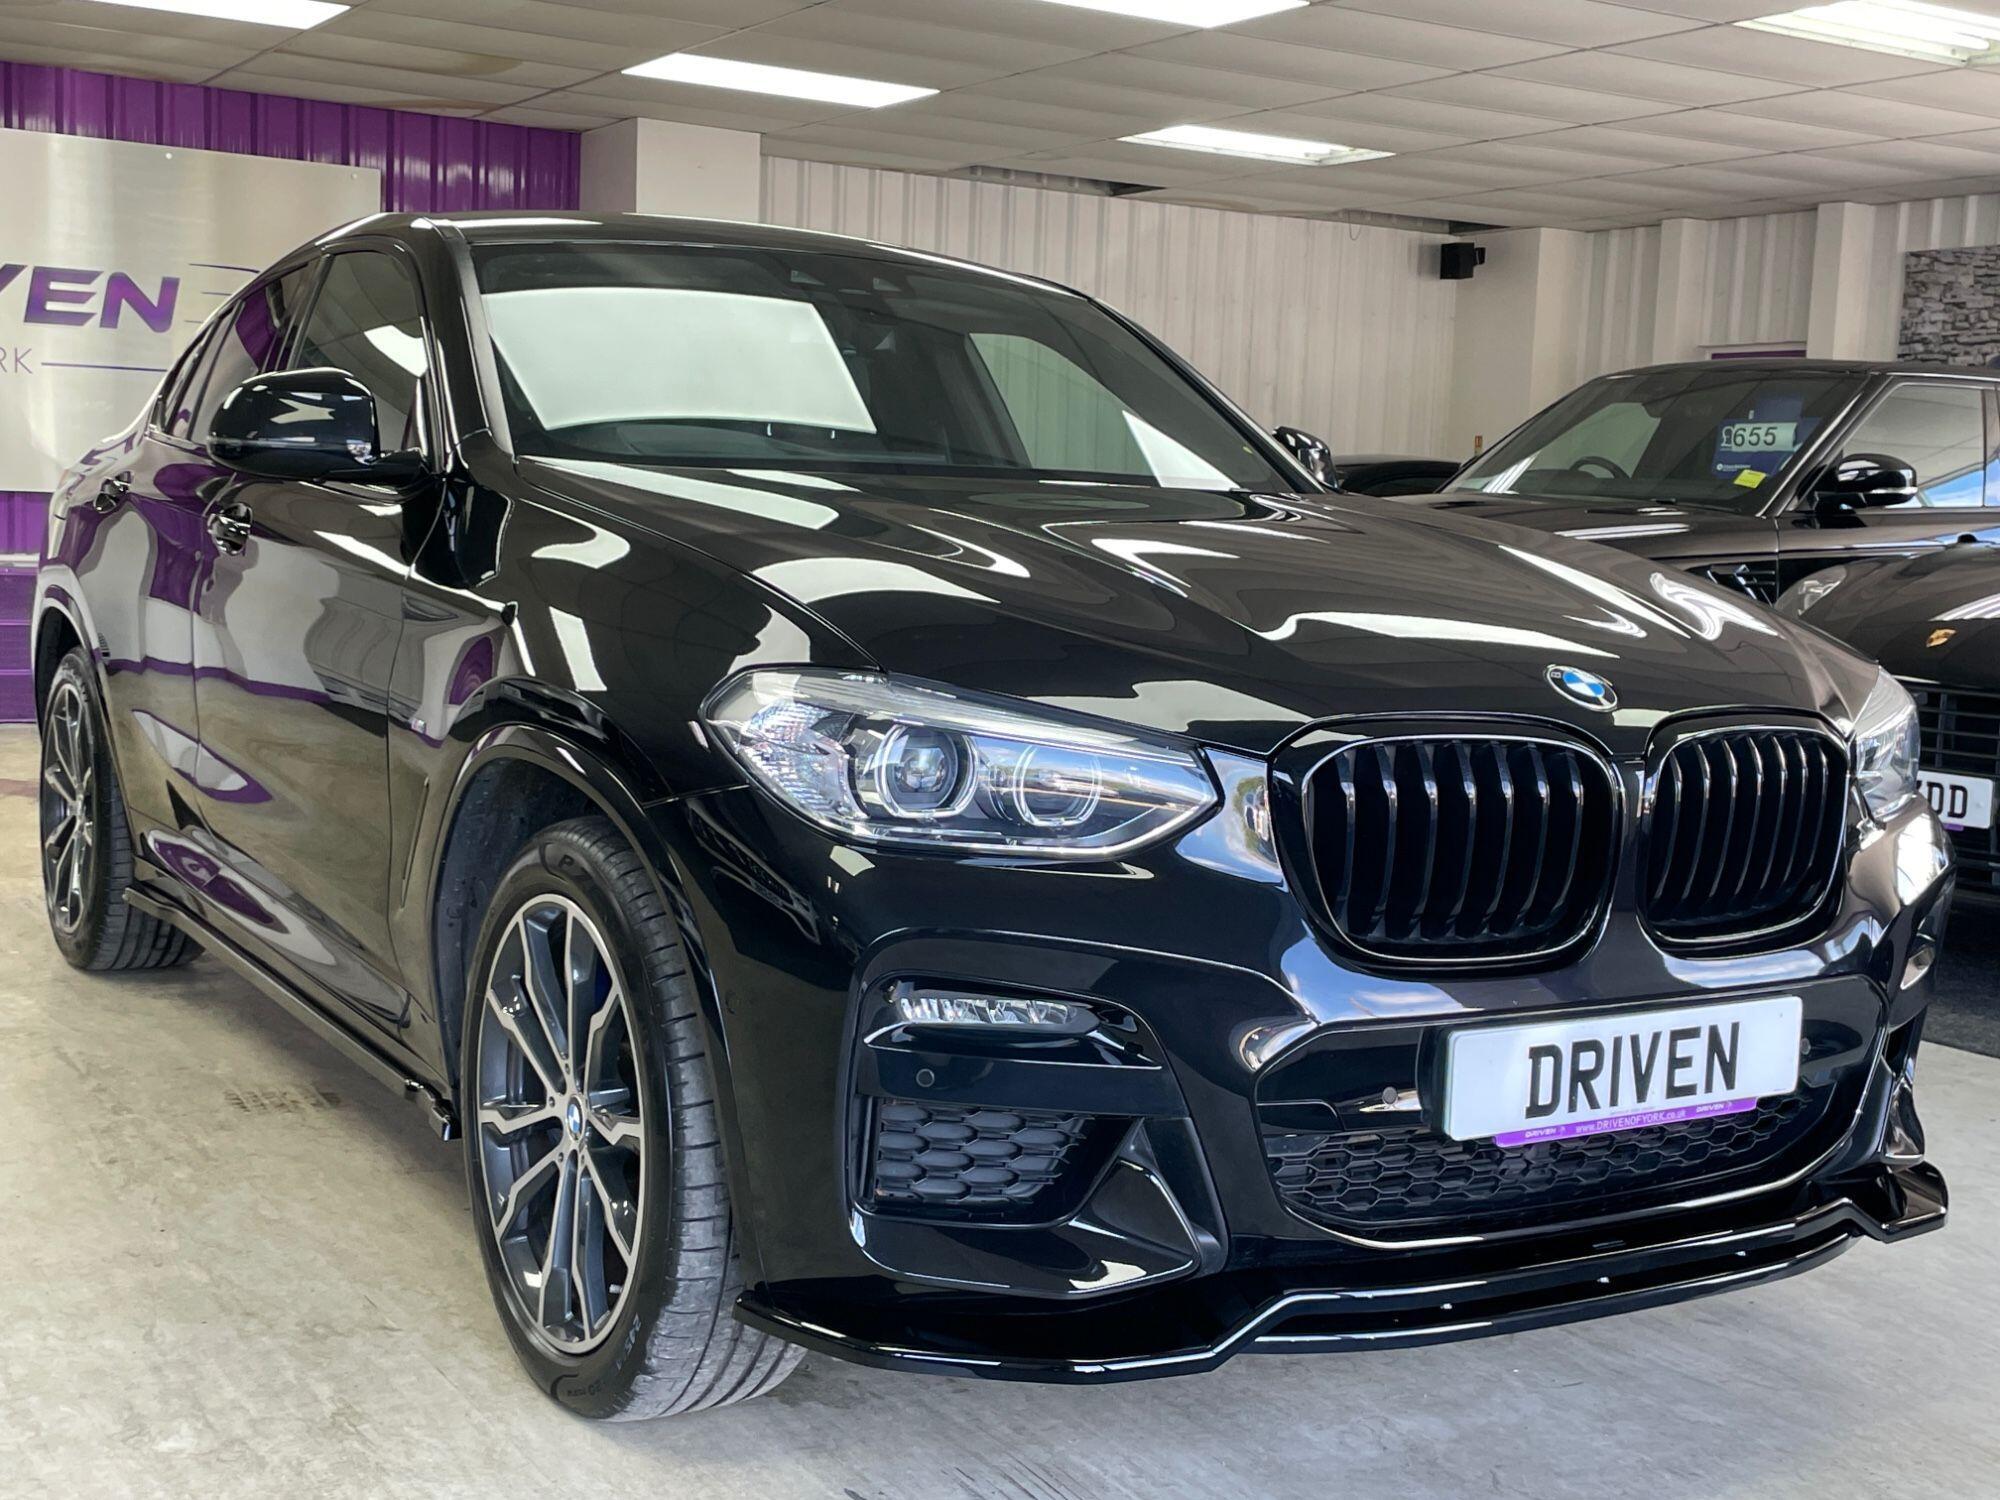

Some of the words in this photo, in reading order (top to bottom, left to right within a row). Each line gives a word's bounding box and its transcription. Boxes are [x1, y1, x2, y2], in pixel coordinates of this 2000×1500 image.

[1916, 780, 1968, 819] DD
[1525, 1022, 1740, 1119] DRIVEN
[1525, 1127, 1557, 1138] DRIVEN
[1696, 1102, 1724, 1113] DRIVEN
